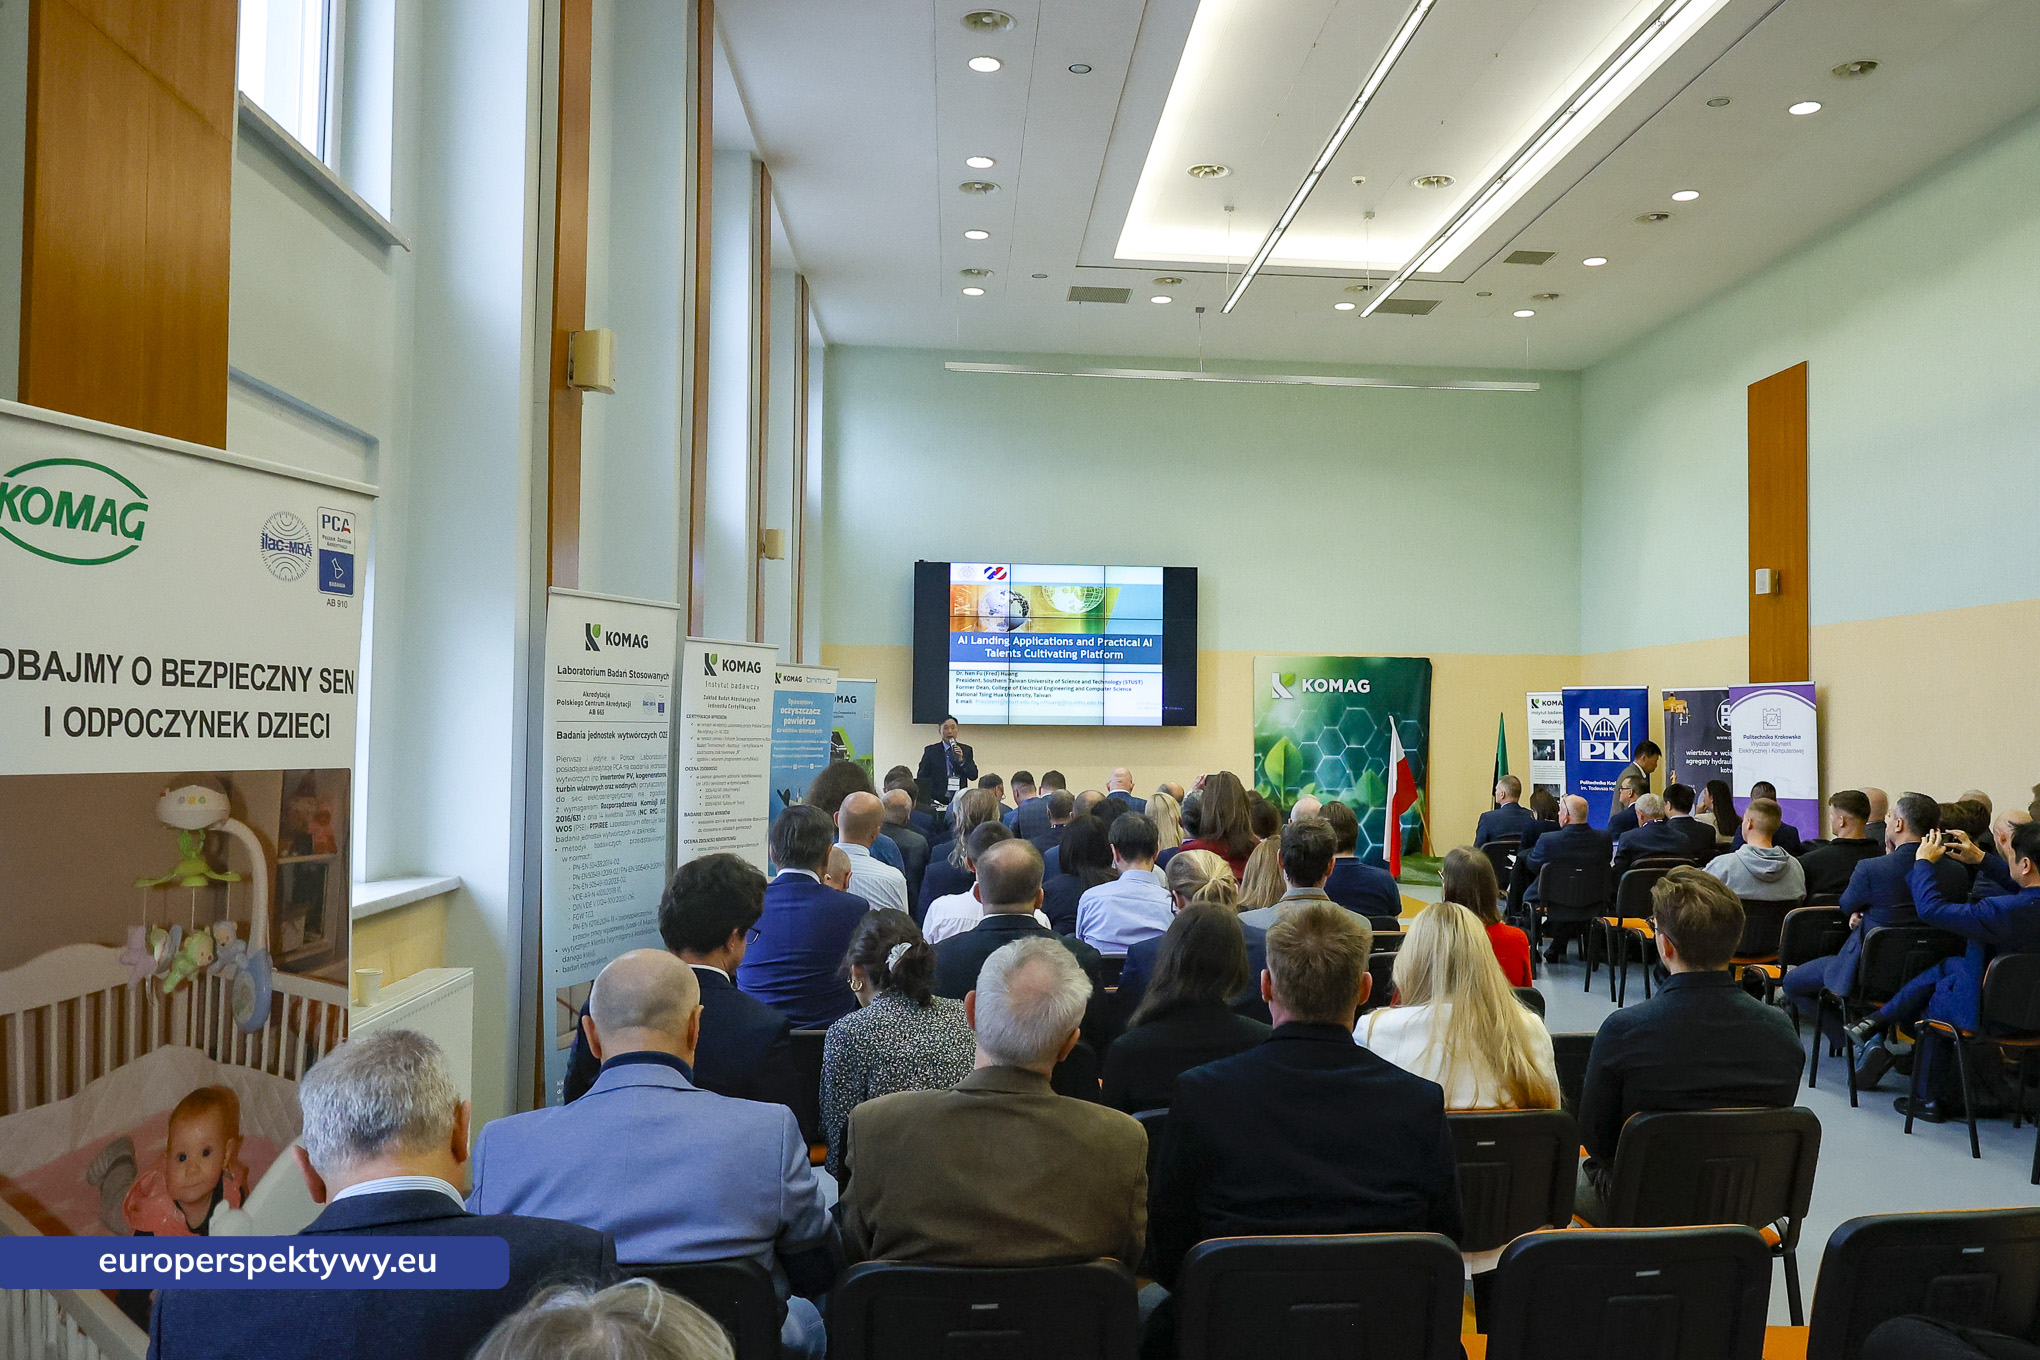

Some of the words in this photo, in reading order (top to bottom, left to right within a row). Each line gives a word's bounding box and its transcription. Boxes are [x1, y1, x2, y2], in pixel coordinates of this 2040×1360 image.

[0, 481, 149, 541] KOMAG
[322, 513, 351, 534] PCA
[326, 598, 336, 607] AB
[337, 600, 348, 609] 910
[605, 630, 649, 649] KOMAG
[957, 635, 968, 645] AI
[970, 635, 1010, 646] Landing
[1012, 636, 1073, 648] Applications
[1076, 637, 1095, 646] and
[1097, 637, 1140, 647] Practical
[1142, 638, 1153, 647] AI
[984, 648, 1021, 658] Talents
[1023, 648, 1078, 660] Cultivating
[1080, 650, 1124, 659] Platform
[722, 659, 761, 674] KOMAG
[131, 656, 152, 686] O
[161, 658, 312, 693] BEZPIECZNY
[319, 668, 354, 695] SEN
[557, 665, 606, 677] Laboratorium
[607, 668, 627, 678] Badań
[629, 670, 670, 682] Stosowanych
[783, 675, 803, 683] KOMAG
[705, 680, 729, 689] Instytut
[731, 682, 760, 691] badawczy
[1301, 678, 1371, 694] KOMAG
[556, 698, 584, 708] Polskiego
[584, 699, 605, 707] Centrum
[605, 700, 632, 709] Akredytacji
[835, 695, 857, 704] MAG
[780, 707, 821, 716] oczyszczacz
[44, 706, 51, 737] I
[63, 706, 250, 739] ODPOCZYNEK
[257, 711, 331, 739] DZIECI
[783, 716, 816, 727] powietrza
[556, 730, 586, 740] Badania
[587, 730, 616, 741] jednostek
[617, 731, 658, 741] wytwórczych
[1580, 742, 1629, 760] PK
[1685, 758, 1710, 766] agregaty
[556, 784, 576, 793] turbin
[556, 795, 565, 803] do
[556, 815, 582, 823] 2016/631
[555, 825, 573, 833] WOS
